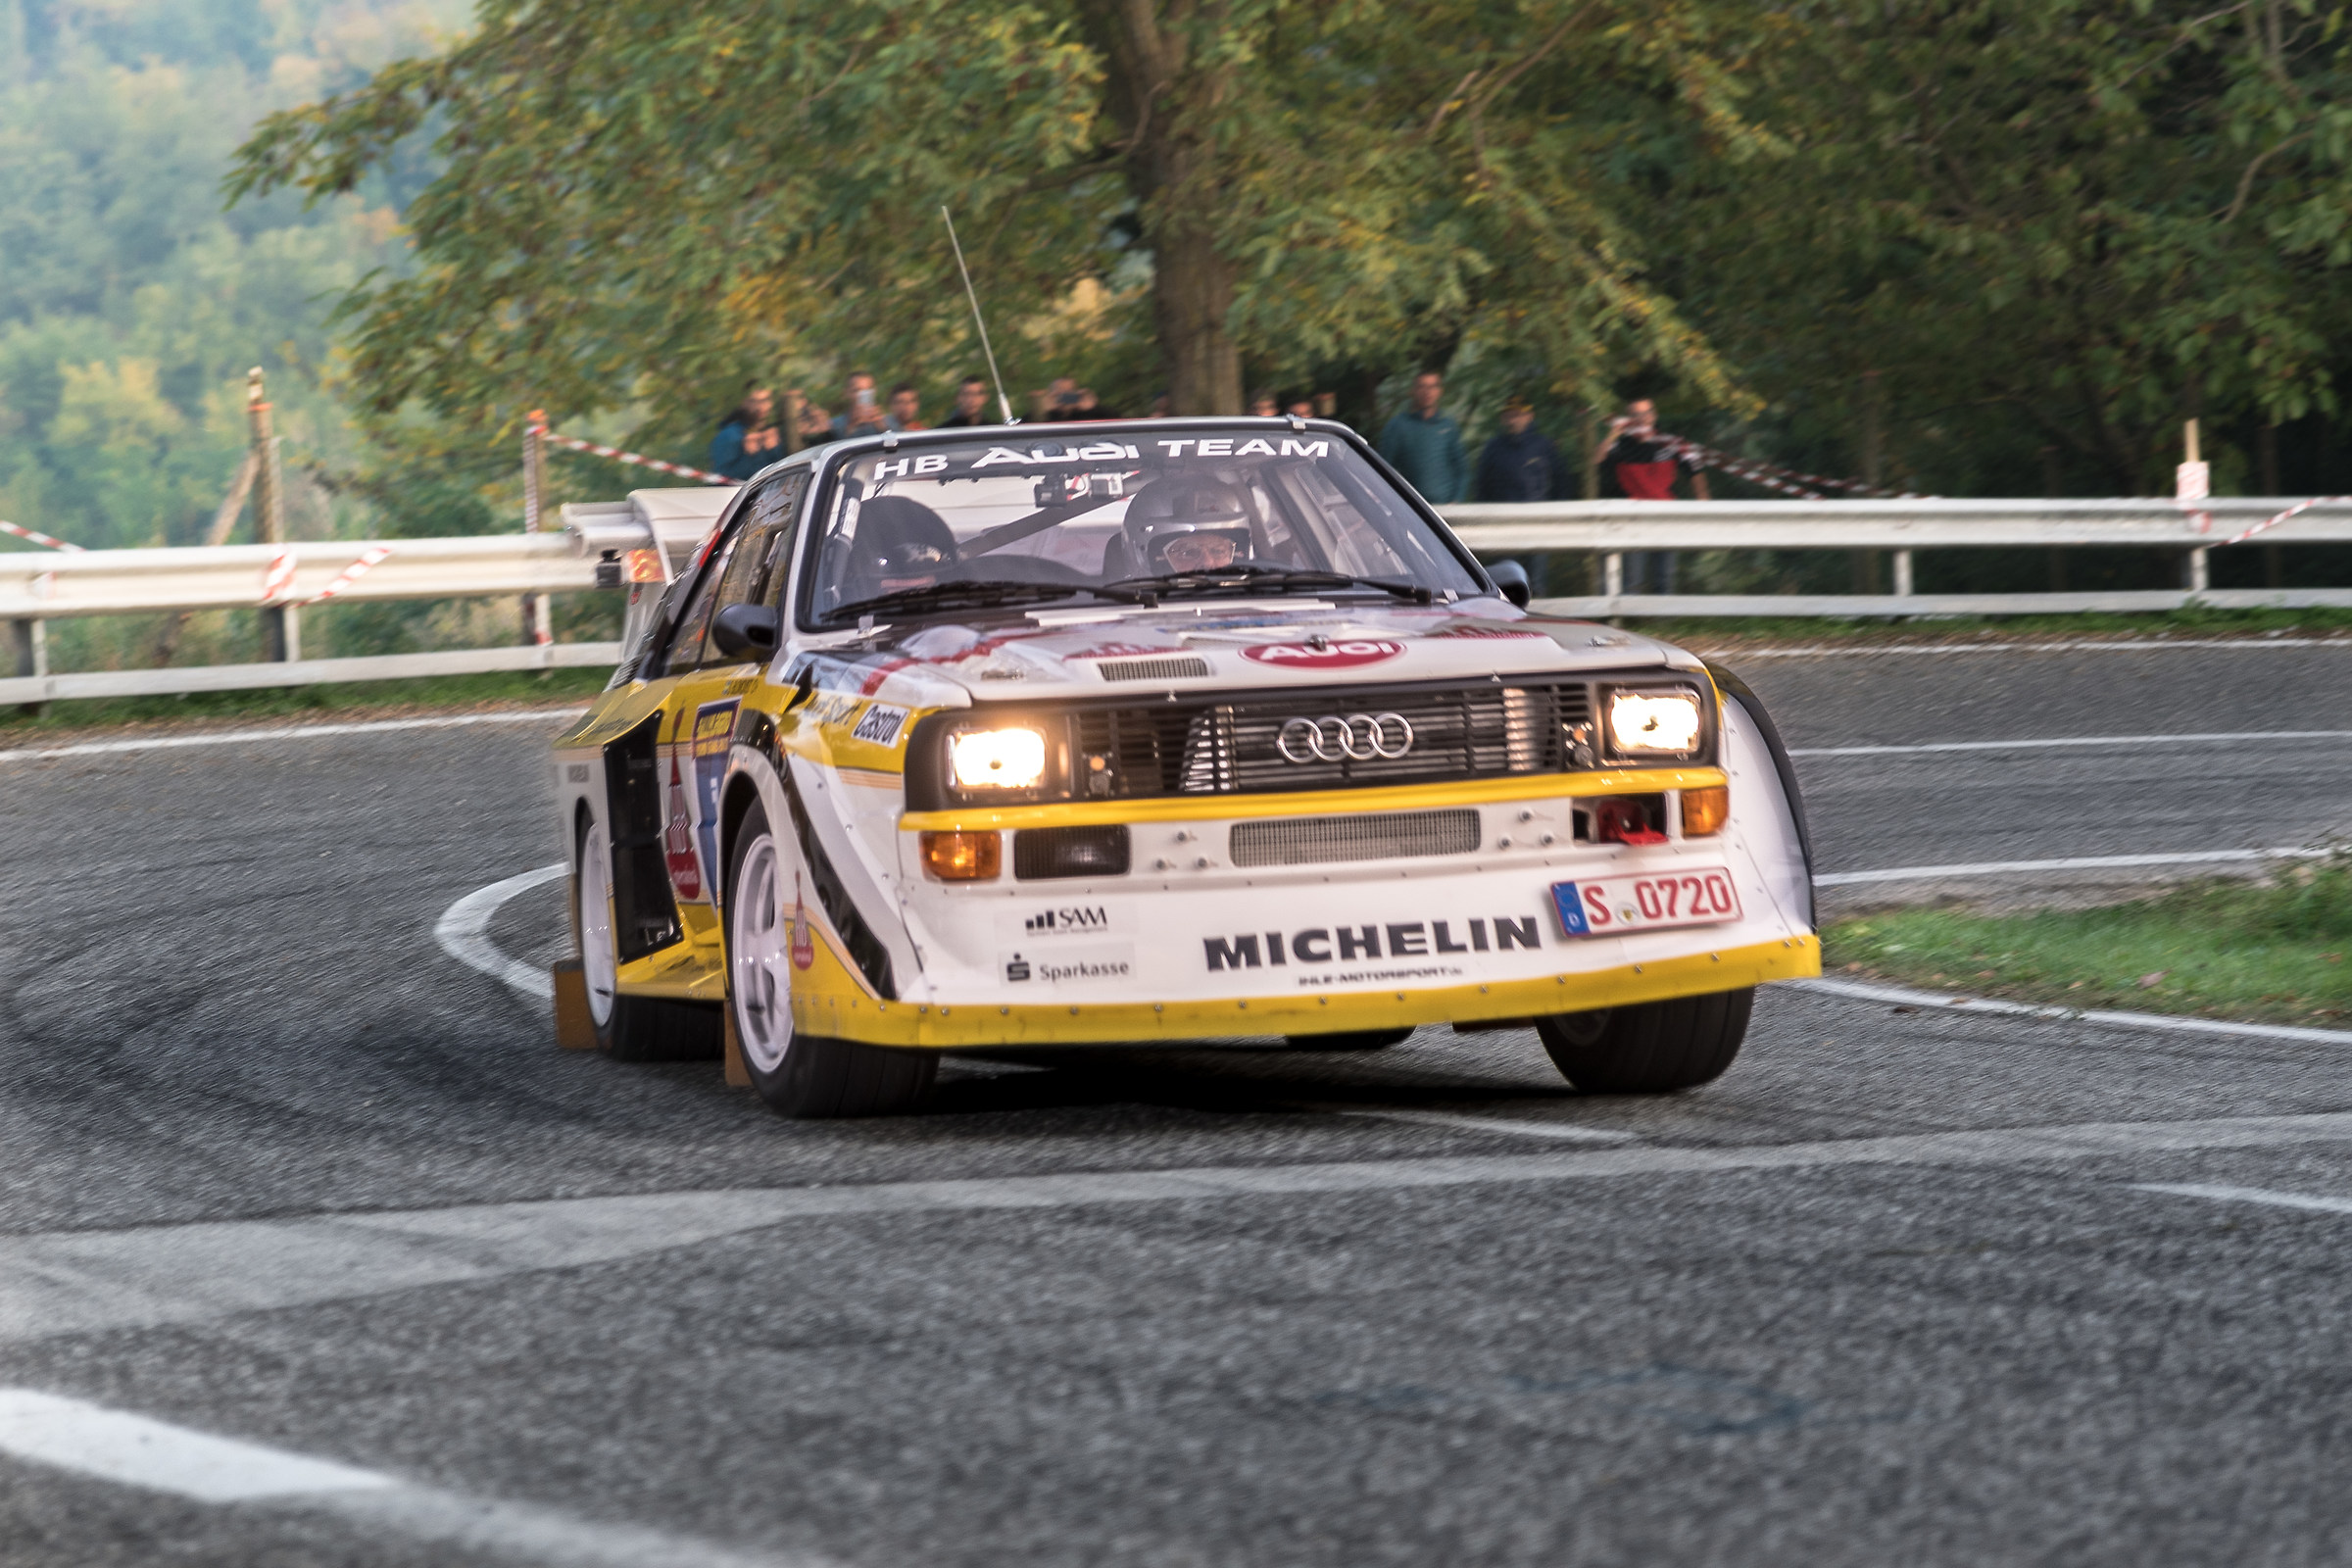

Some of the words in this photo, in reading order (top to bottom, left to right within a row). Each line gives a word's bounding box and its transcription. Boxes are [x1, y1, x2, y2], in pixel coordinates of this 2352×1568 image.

[873, 453, 949, 481] HB
[1157, 438, 1329, 458] TEAM
[853, 704, 908, 745] Castrol
[1058, 906, 1108, 929] SAM
[1583, 885, 1612, 926] S
[1635, 874, 1734, 919] 0720
[1203, 915, 1543, 972] MICHELIN
[1039, 961, 1129, 984] Sparkasse
